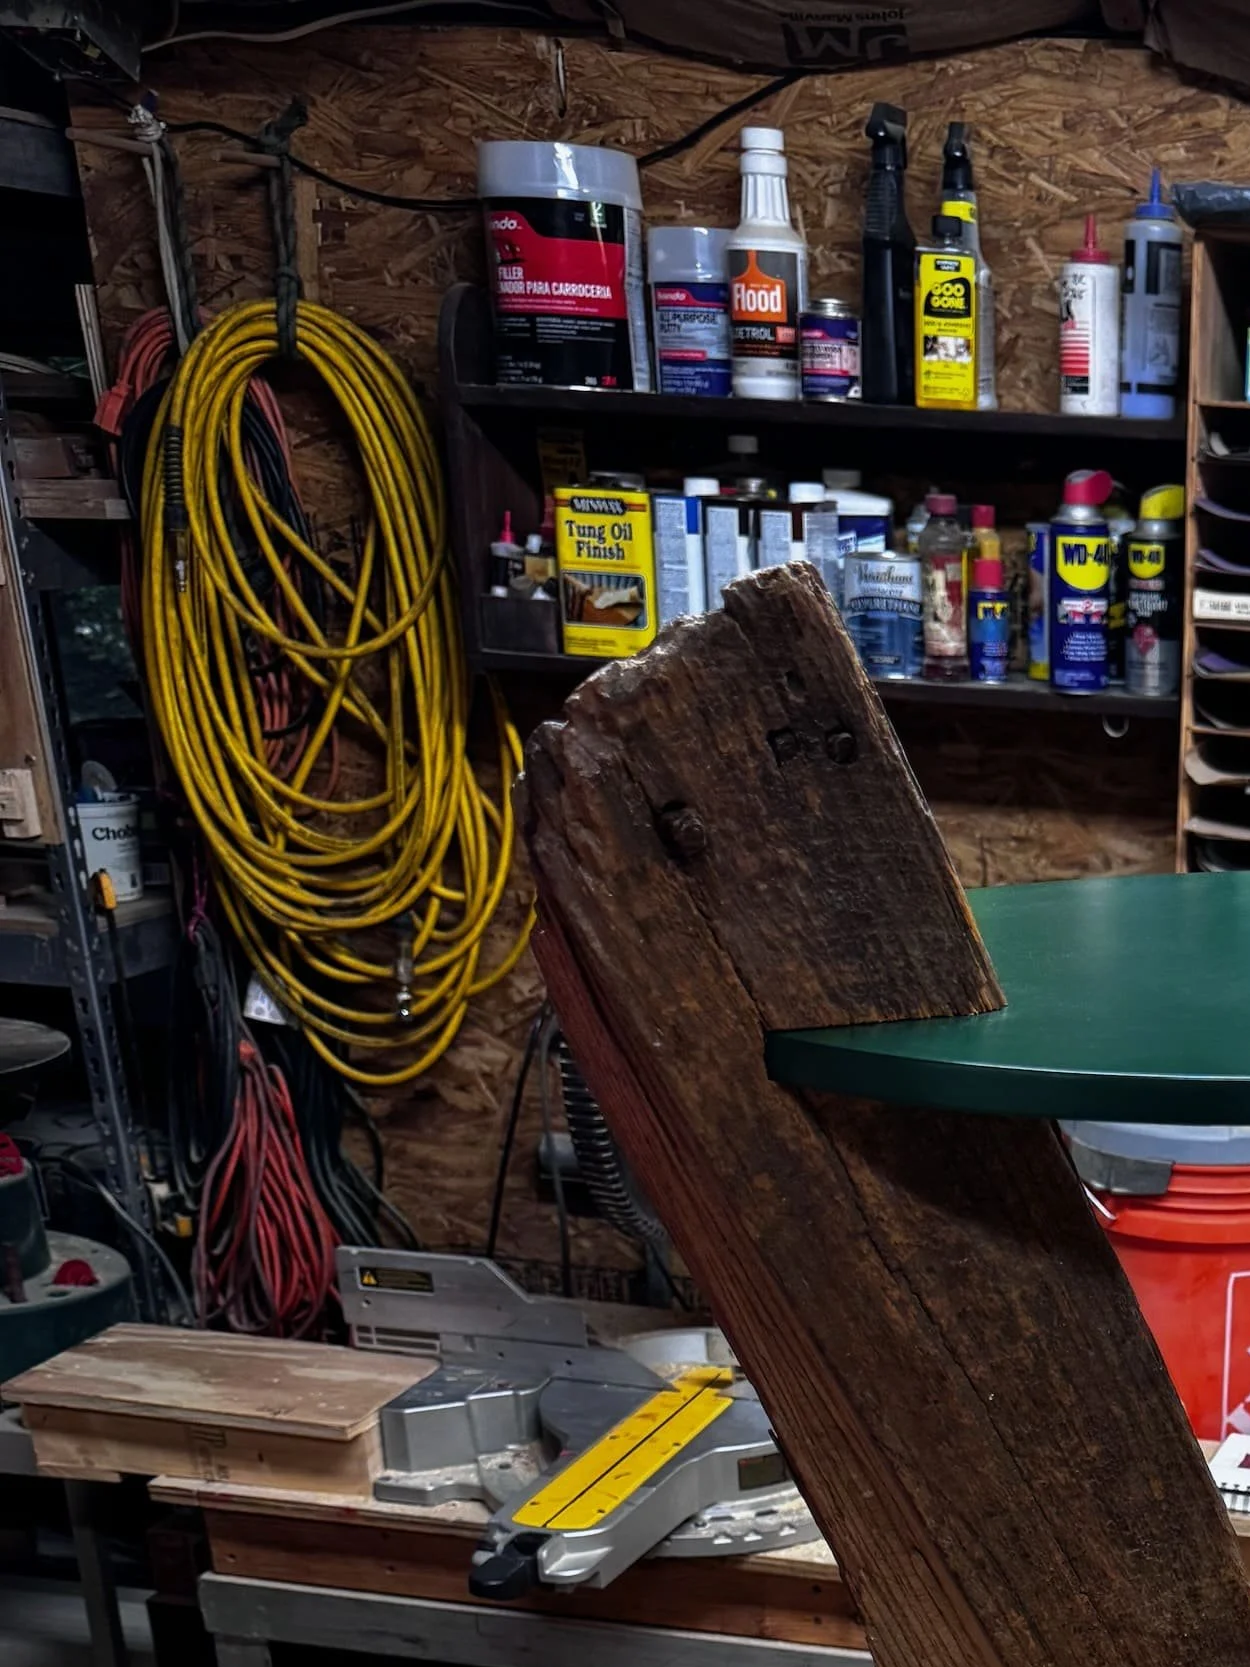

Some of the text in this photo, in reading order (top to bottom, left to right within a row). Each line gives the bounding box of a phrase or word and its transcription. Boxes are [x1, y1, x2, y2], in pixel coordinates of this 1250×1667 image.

[491, 217, 518, 230] ndo
[733, 282, 783, 314] Flood
[565, 520, 633, 544] Tung Oil
[576, 540, 625, 560] Finish
